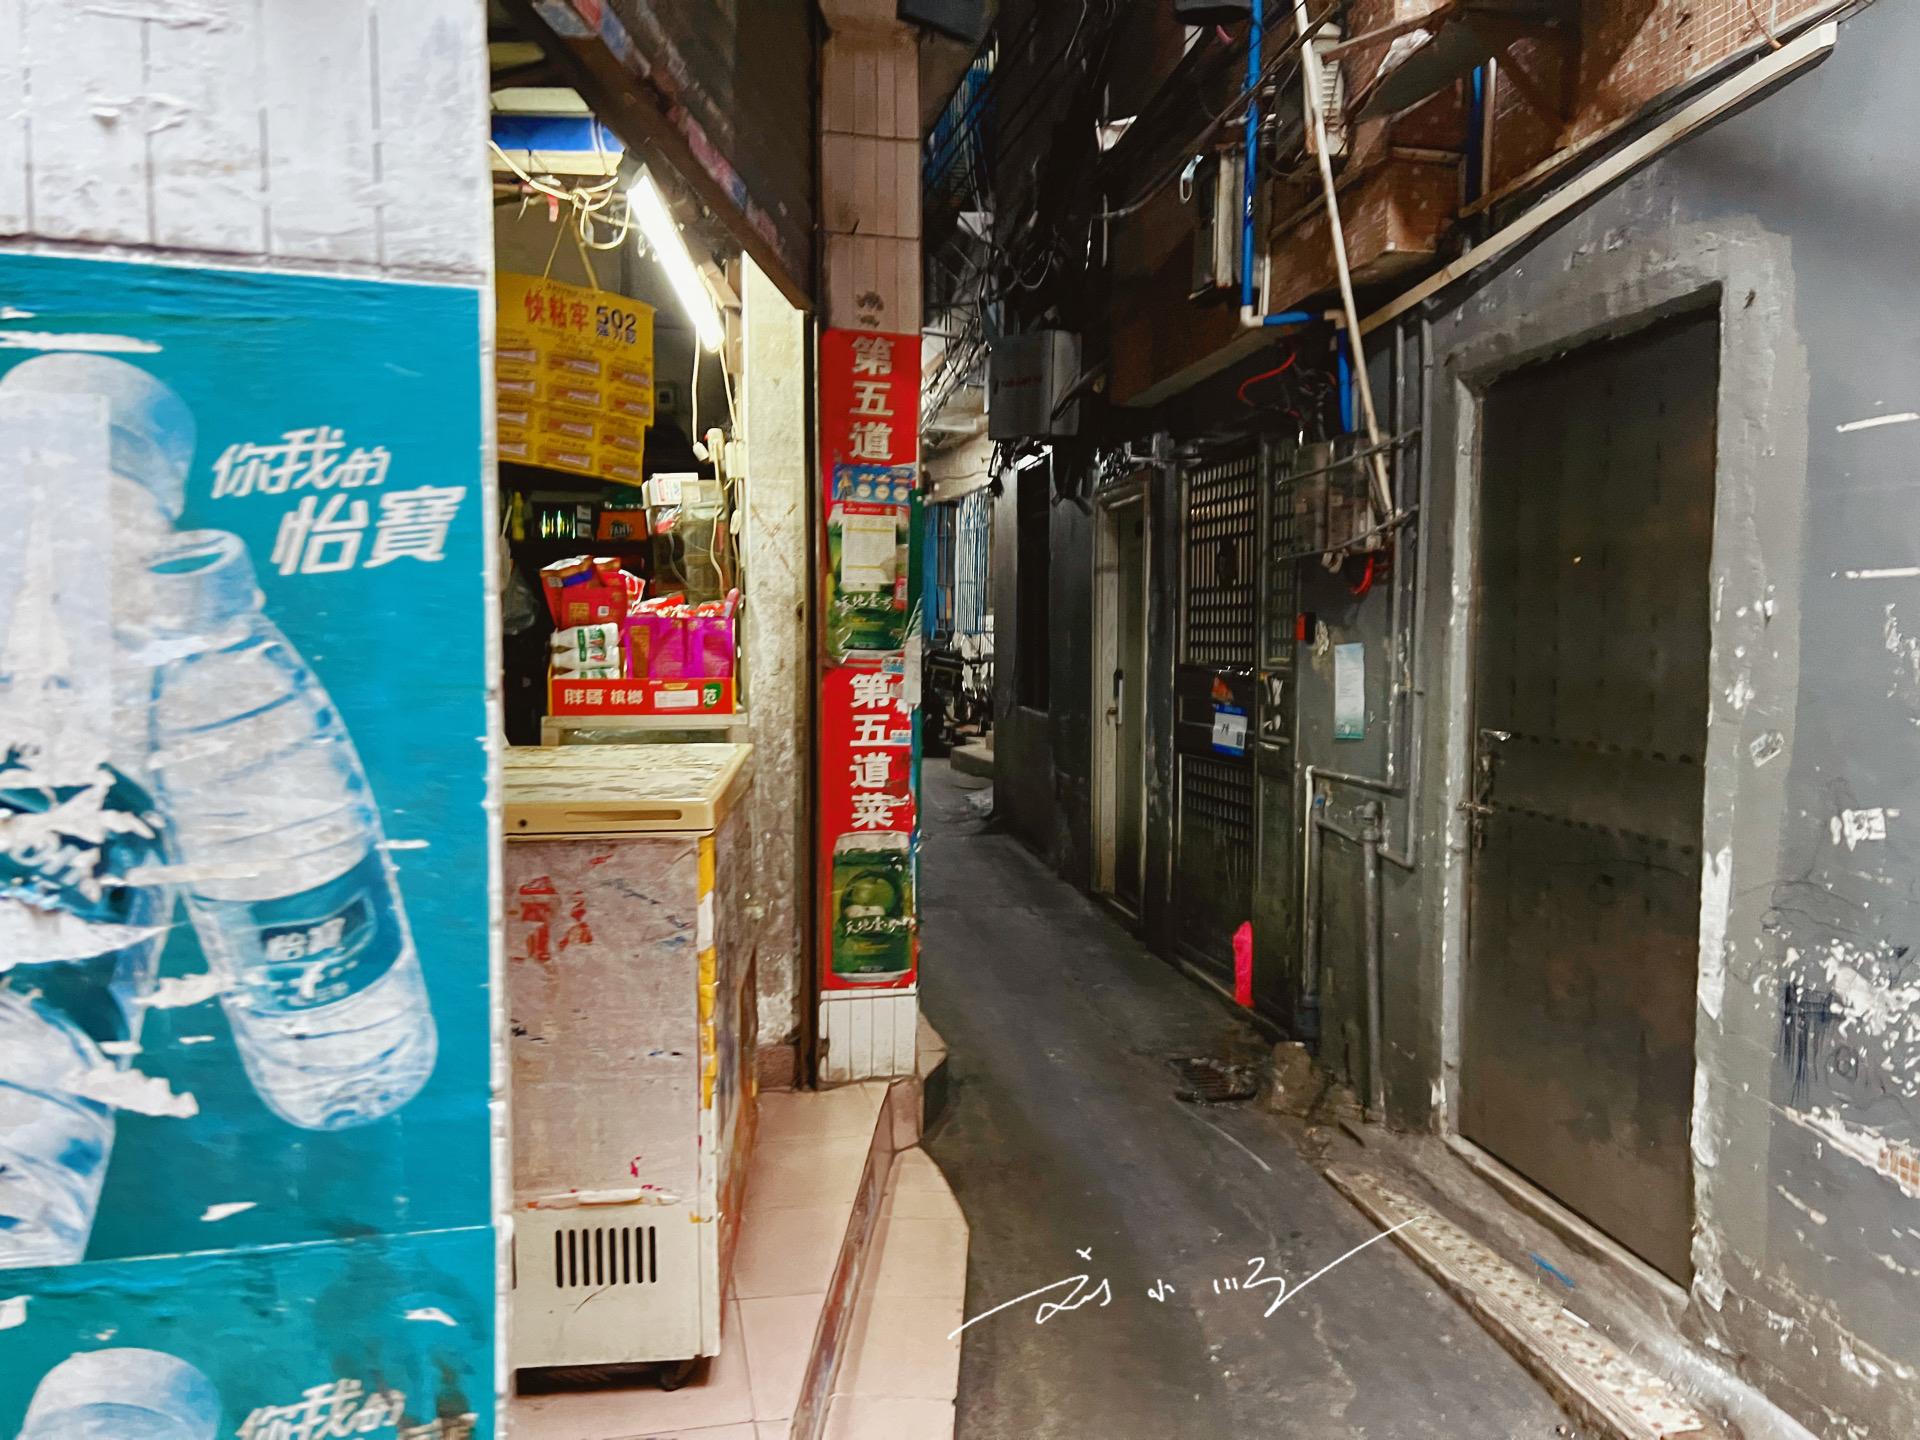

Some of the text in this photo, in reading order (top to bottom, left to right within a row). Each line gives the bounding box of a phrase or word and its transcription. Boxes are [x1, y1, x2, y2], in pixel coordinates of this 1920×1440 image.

[596, 306, 637, 331] 502
[849, 336, 896, 466] 第五道
[211, 426, 392, 498] 你我的
[270, 485, 467, 576] 怡寶
[849, 672, 895, 830] 第五道菜
